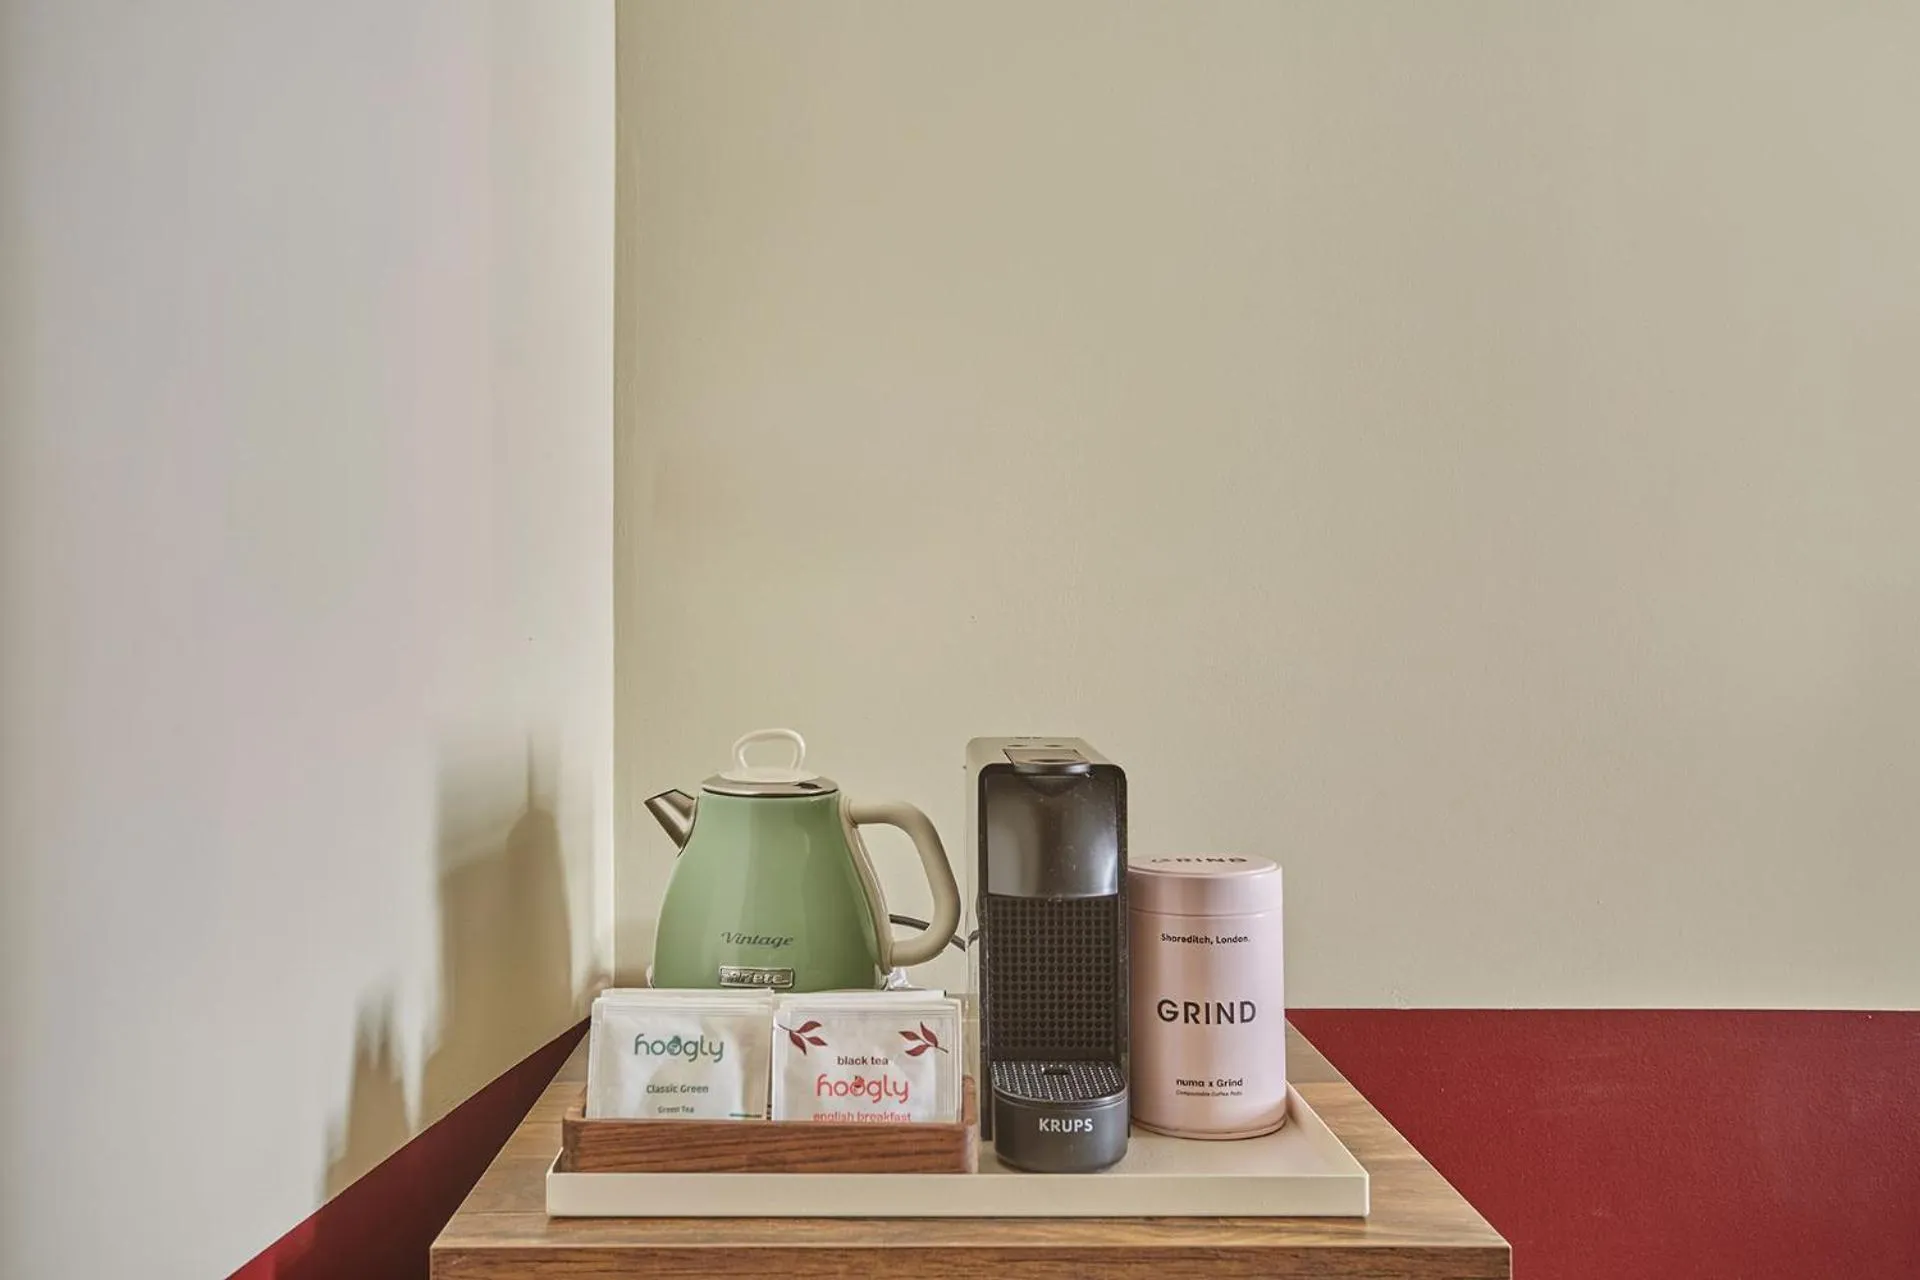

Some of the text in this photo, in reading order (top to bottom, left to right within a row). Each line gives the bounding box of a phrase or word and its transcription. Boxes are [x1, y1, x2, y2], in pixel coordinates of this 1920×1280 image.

[721, 931, 794, 948] Vintage
[1161, 933, 1213, 945] Shoreditch,
[1157, 999, 1256, 1025] GRIND
[634, 1033, 724, 1063] hoogly
[837, 1056, 888, 1065] black tea
[646, 1084, 709, 1094] Classic Green
[817, 1073, 909, 1104] hoogly
[1176, 1079, 1204, 1087] numa
[1216, 1078, 1243, 1087] Grind
[1039, 1118, 1093, 1132] KRUPS
